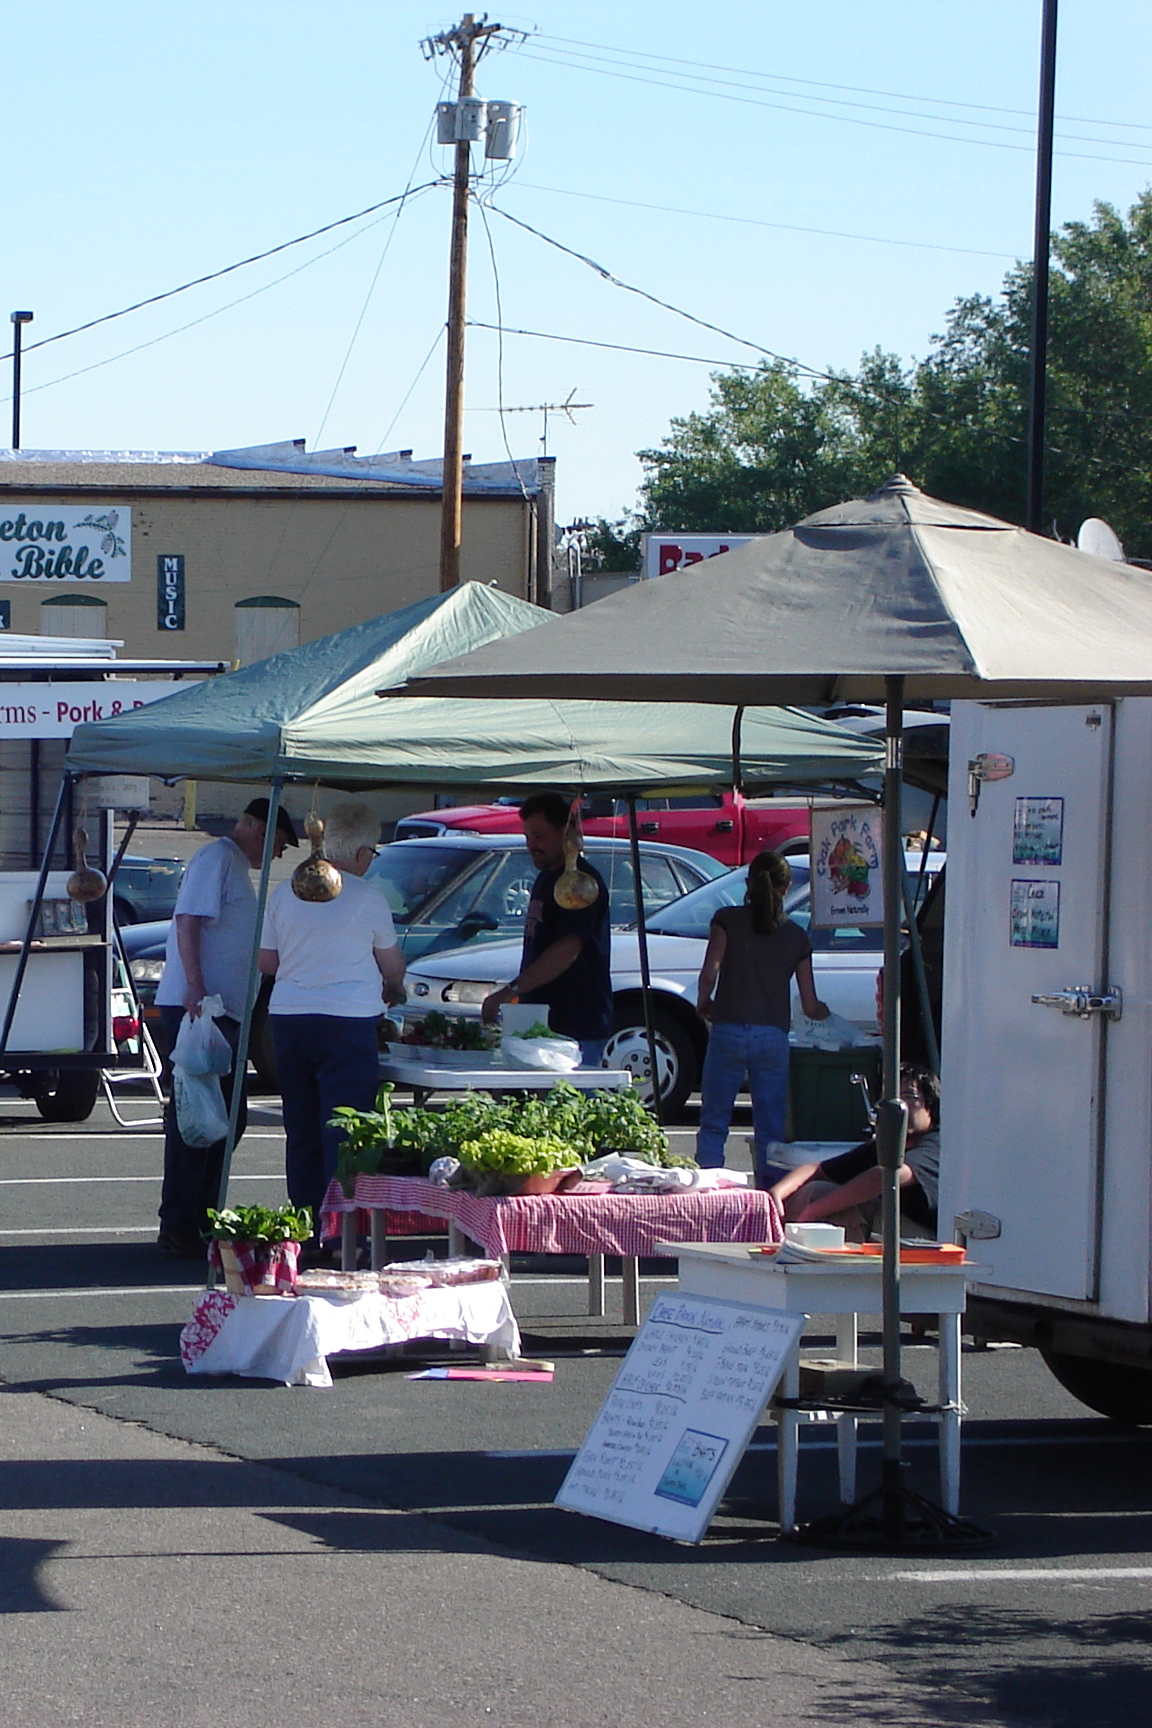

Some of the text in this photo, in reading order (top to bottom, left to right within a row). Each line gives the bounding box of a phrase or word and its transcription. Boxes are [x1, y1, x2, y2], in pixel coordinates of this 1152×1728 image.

[11, 544, 107, 579] Bible
[163, 557, 179, 629] MUSIC
[56, 700, 102, 723] Pork
[817, 814, 879, 876] Oak Park Farm
